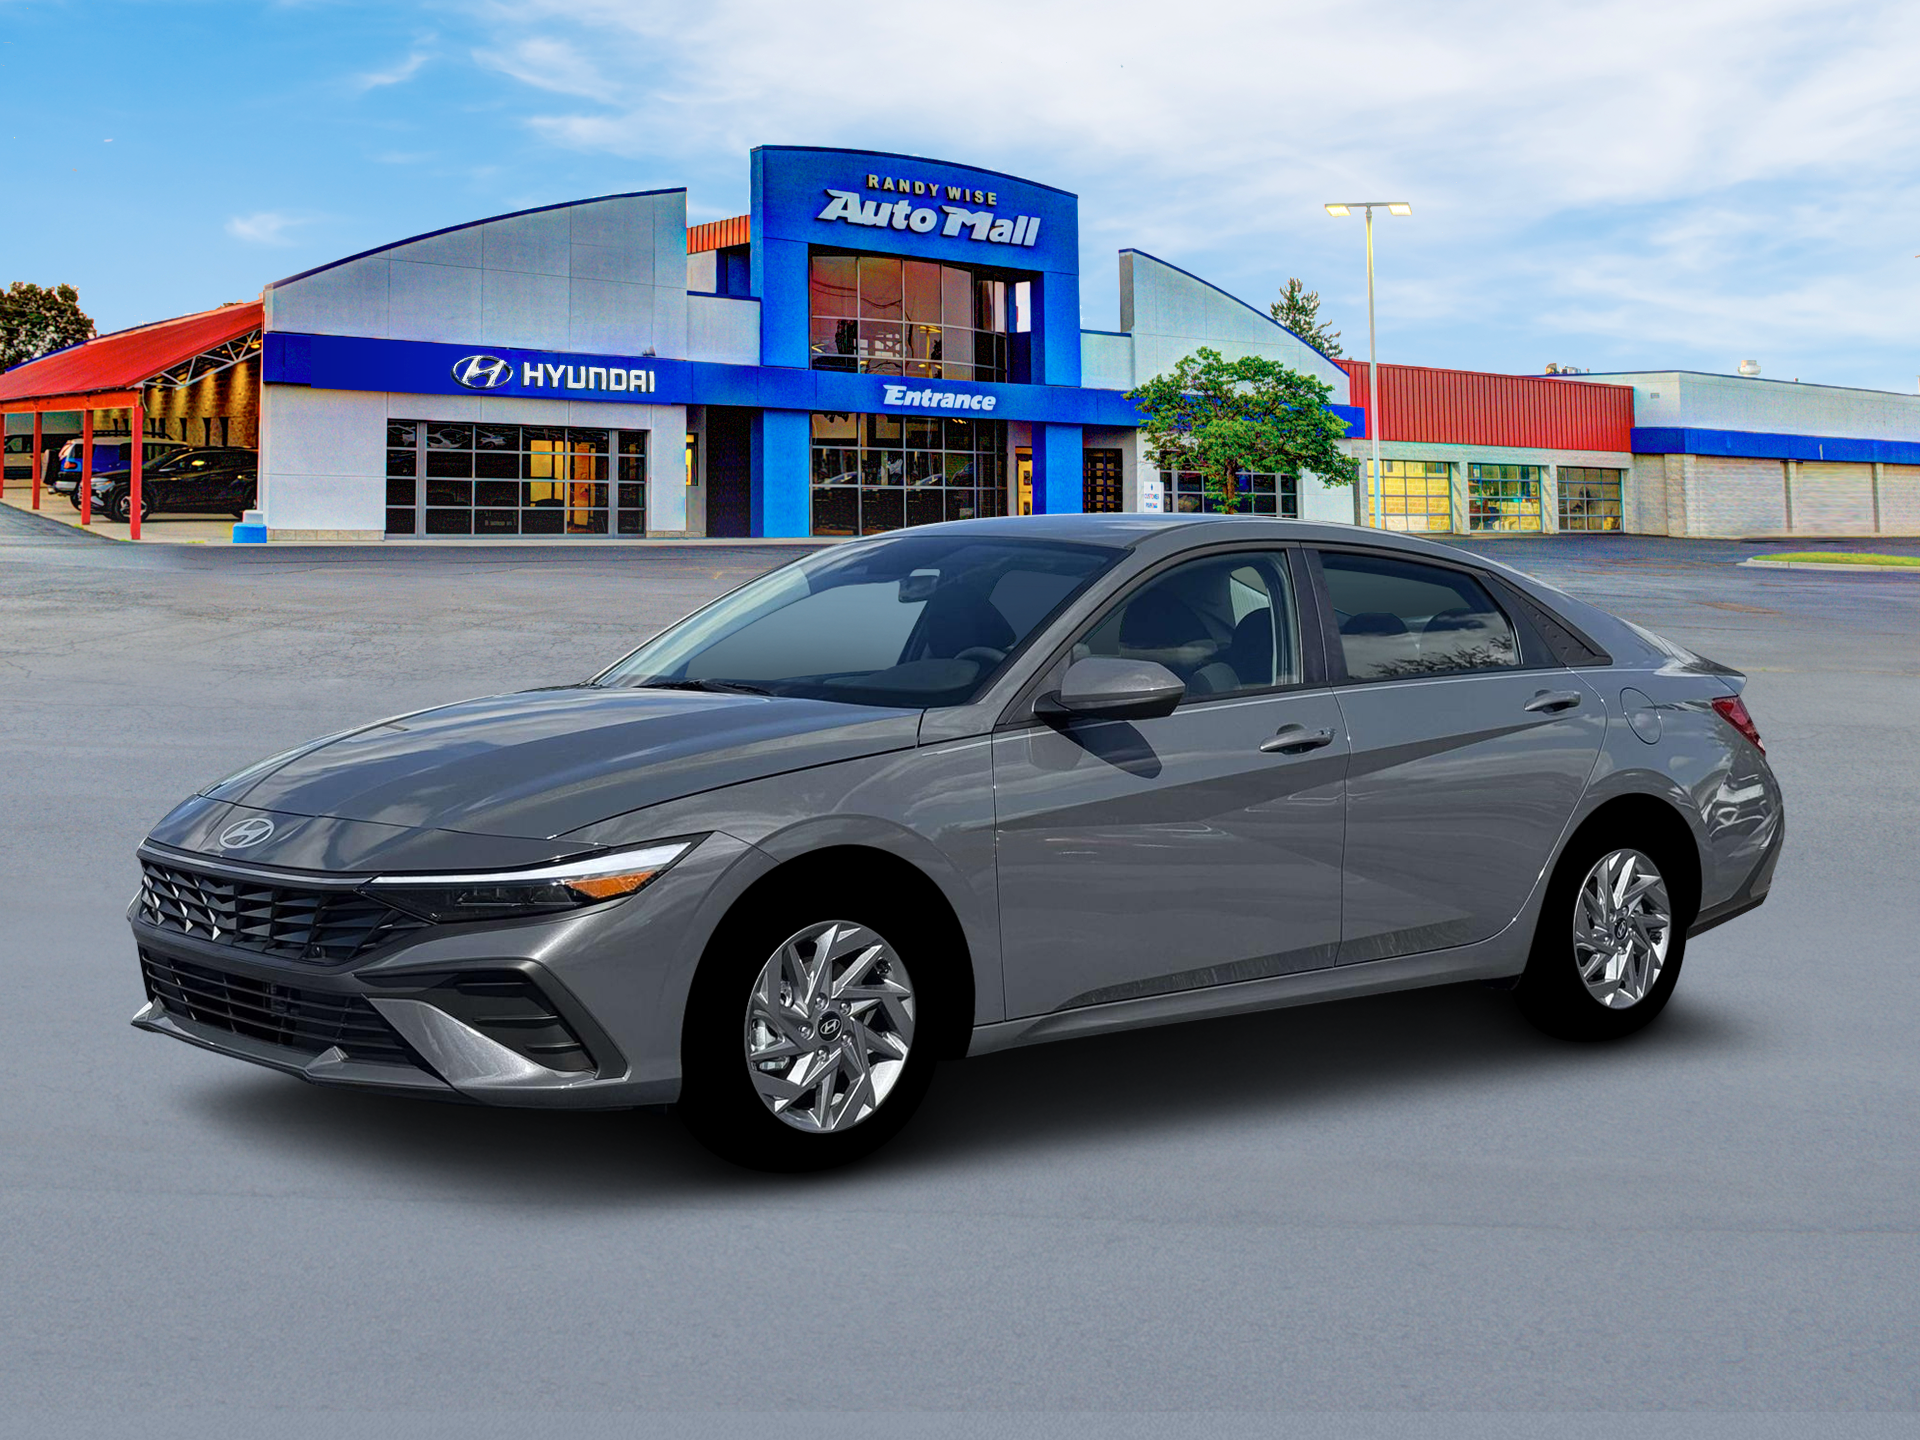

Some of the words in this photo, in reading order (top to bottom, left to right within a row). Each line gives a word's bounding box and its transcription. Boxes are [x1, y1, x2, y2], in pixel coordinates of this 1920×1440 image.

[866, 174, 940, 197] RANDY
[946, 186, 997, 206] WISE
[816, 188, 938, 233] Auto
[940, 205, 1041, 247] Mall
[521, 361, 656, 393] HYUNDAI
[882, 384, 997, 411] Entrance
